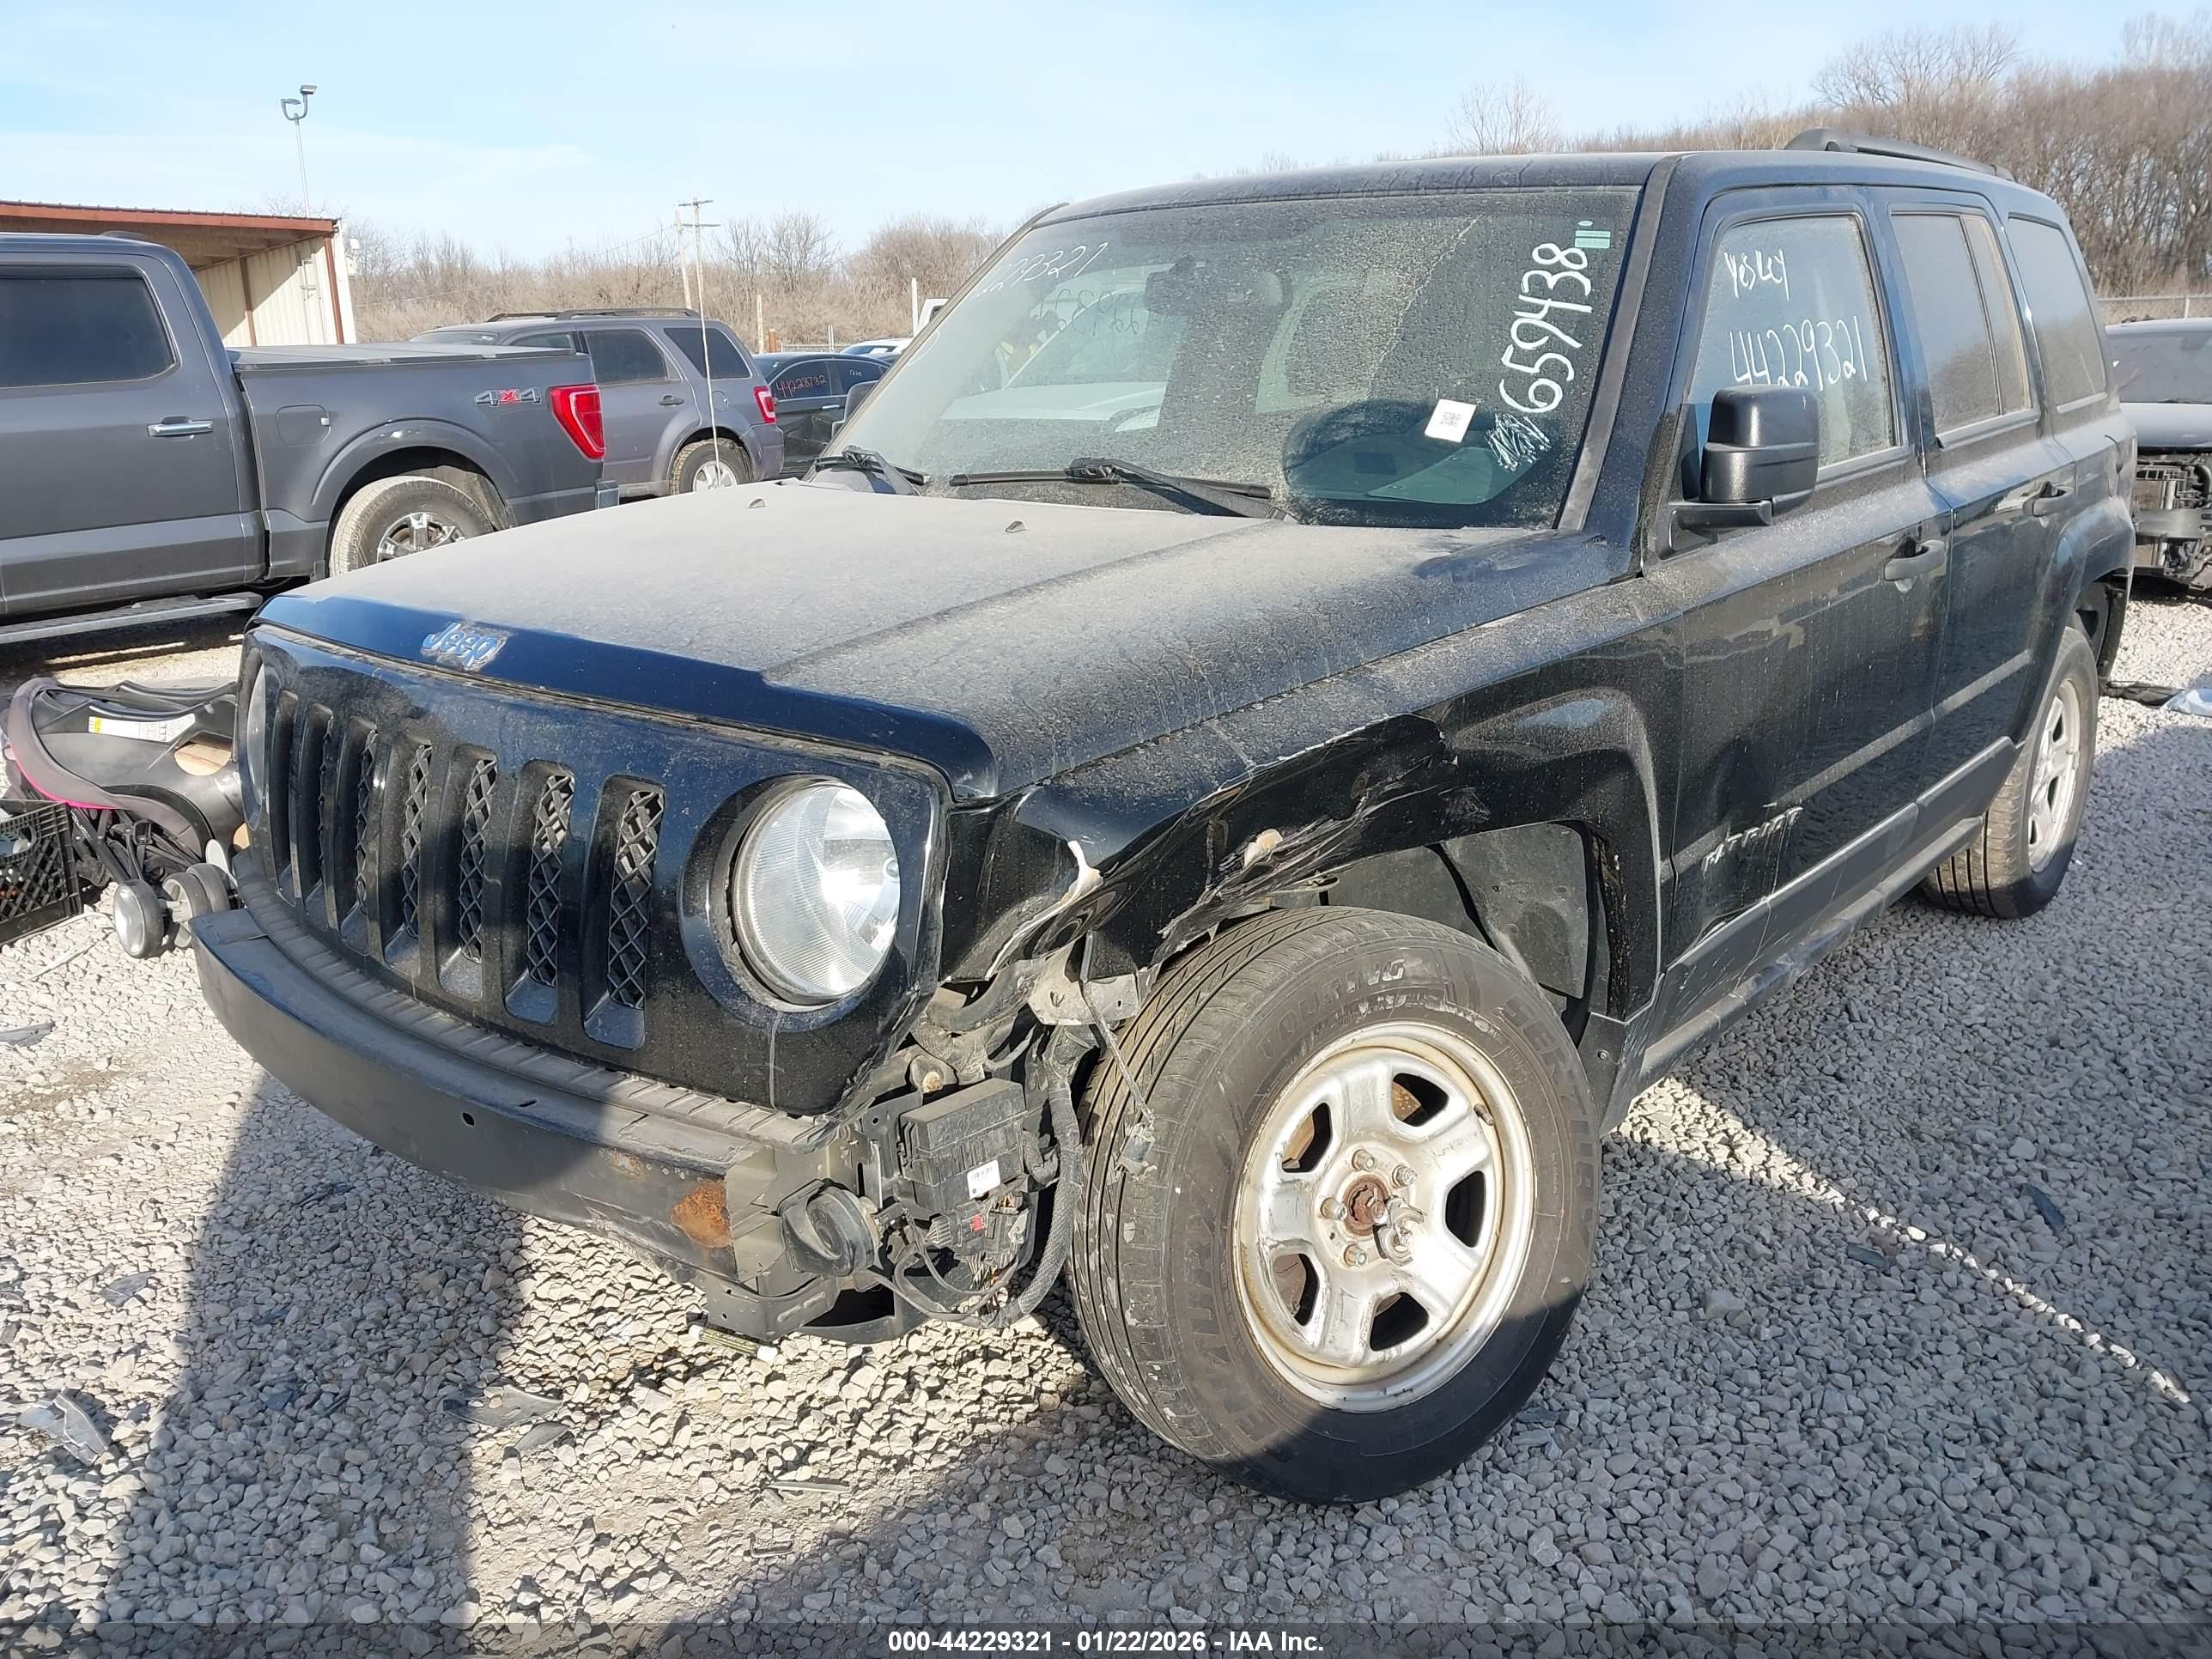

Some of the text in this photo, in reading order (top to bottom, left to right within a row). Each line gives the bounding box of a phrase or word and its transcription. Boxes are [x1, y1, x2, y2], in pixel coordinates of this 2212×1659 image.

[1499, 242, 1593, 412] 659438
[1730, 316, 1868, 391] 44229321
[422, 622, 498, 667] Jeep
